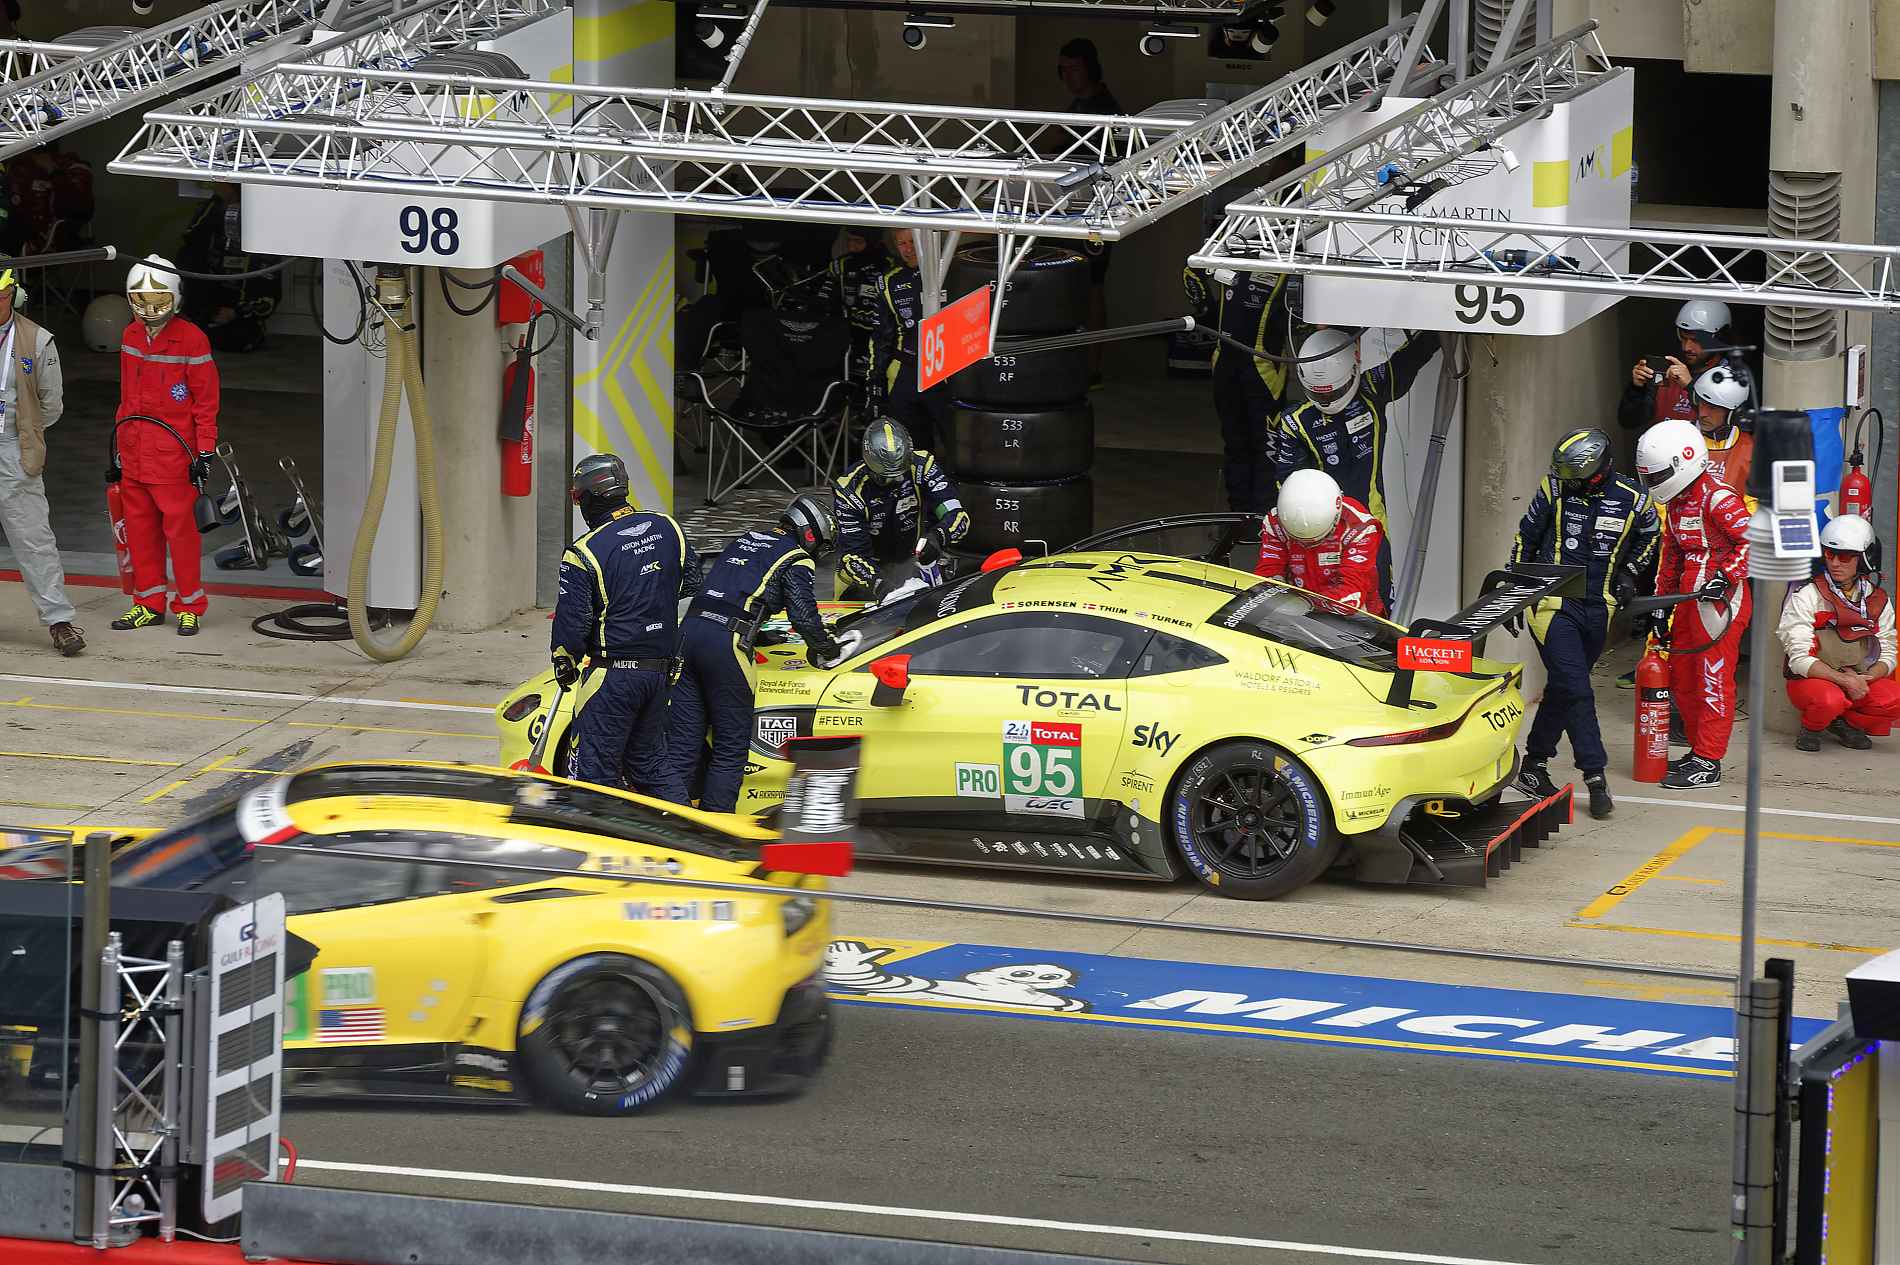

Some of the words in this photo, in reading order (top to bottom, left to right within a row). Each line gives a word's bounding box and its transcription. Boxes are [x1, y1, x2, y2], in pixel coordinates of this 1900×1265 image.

[1430, 205, 1512, 222] MARTIN
[400, 205, 459, 256] 98
[1393, 228, 1469, 248] RACING
[990, 280, 1014, 292] 53
[1454, 284, 1525, 326] 95
[925, 323, 945, 377] 95
[993, 356, 1016, 366] 533
[999, 372, 1014, 382] RF
[1002, 419, 1023, 431] 533
[1004, 439, 1020, 448] LR
[995, 498, 1020, 511] 533
[1003, 521, 1020, 533] RR
[621, 541, 641, 552] ASTON
[641, 533, 663, 546] MARTIN
[633, 544, 655, 555] RACING
[1017, 600, 1078, 609] SØRENSEN
[1099, 605, 1129, 615] THIIM
[1151, 613, 1193, 629] TURNER
[1405, 644, 1465, 660] HACKETT
[1419, 657, 1449, 665] LONDON
[759, 679, 777, 688] Royal
[778, 680, 787, 688] Air
[788, 680, 806, 688] Force
[1235, 671, 1281, 682] WALDORF
[1282, 678, 1321, 689] ASTORIA
[759, 686, 792, 695] Benevolent
[794, 687, 811, 696] Fund
[1016, 684, 1121, 711] TOTAL
[818, 716, 863, 726] #FEVER
[1481, 700, 1522, 731] TOTAL
[762, 719, 793, 728] TAG
[760, 731, 794, 745] HEUER
[1033, 728, 1080, 741] TOTAL
[1132, 721, 1181, 757] sky
[1010, 745, 1075, 796] 95
[958, 768, 998, 793] PRO
[1121, 776, 1155, 794] SPIRENT
[759, 790, 786, 799] AKRAPOV
[1025, 797, 1073, 811] WEC
[1294, 773, 1318, 842] MICHELIN
[1175, 803, 1203, 869] MICHELIN
[220, 951, 243, 967] GULF
